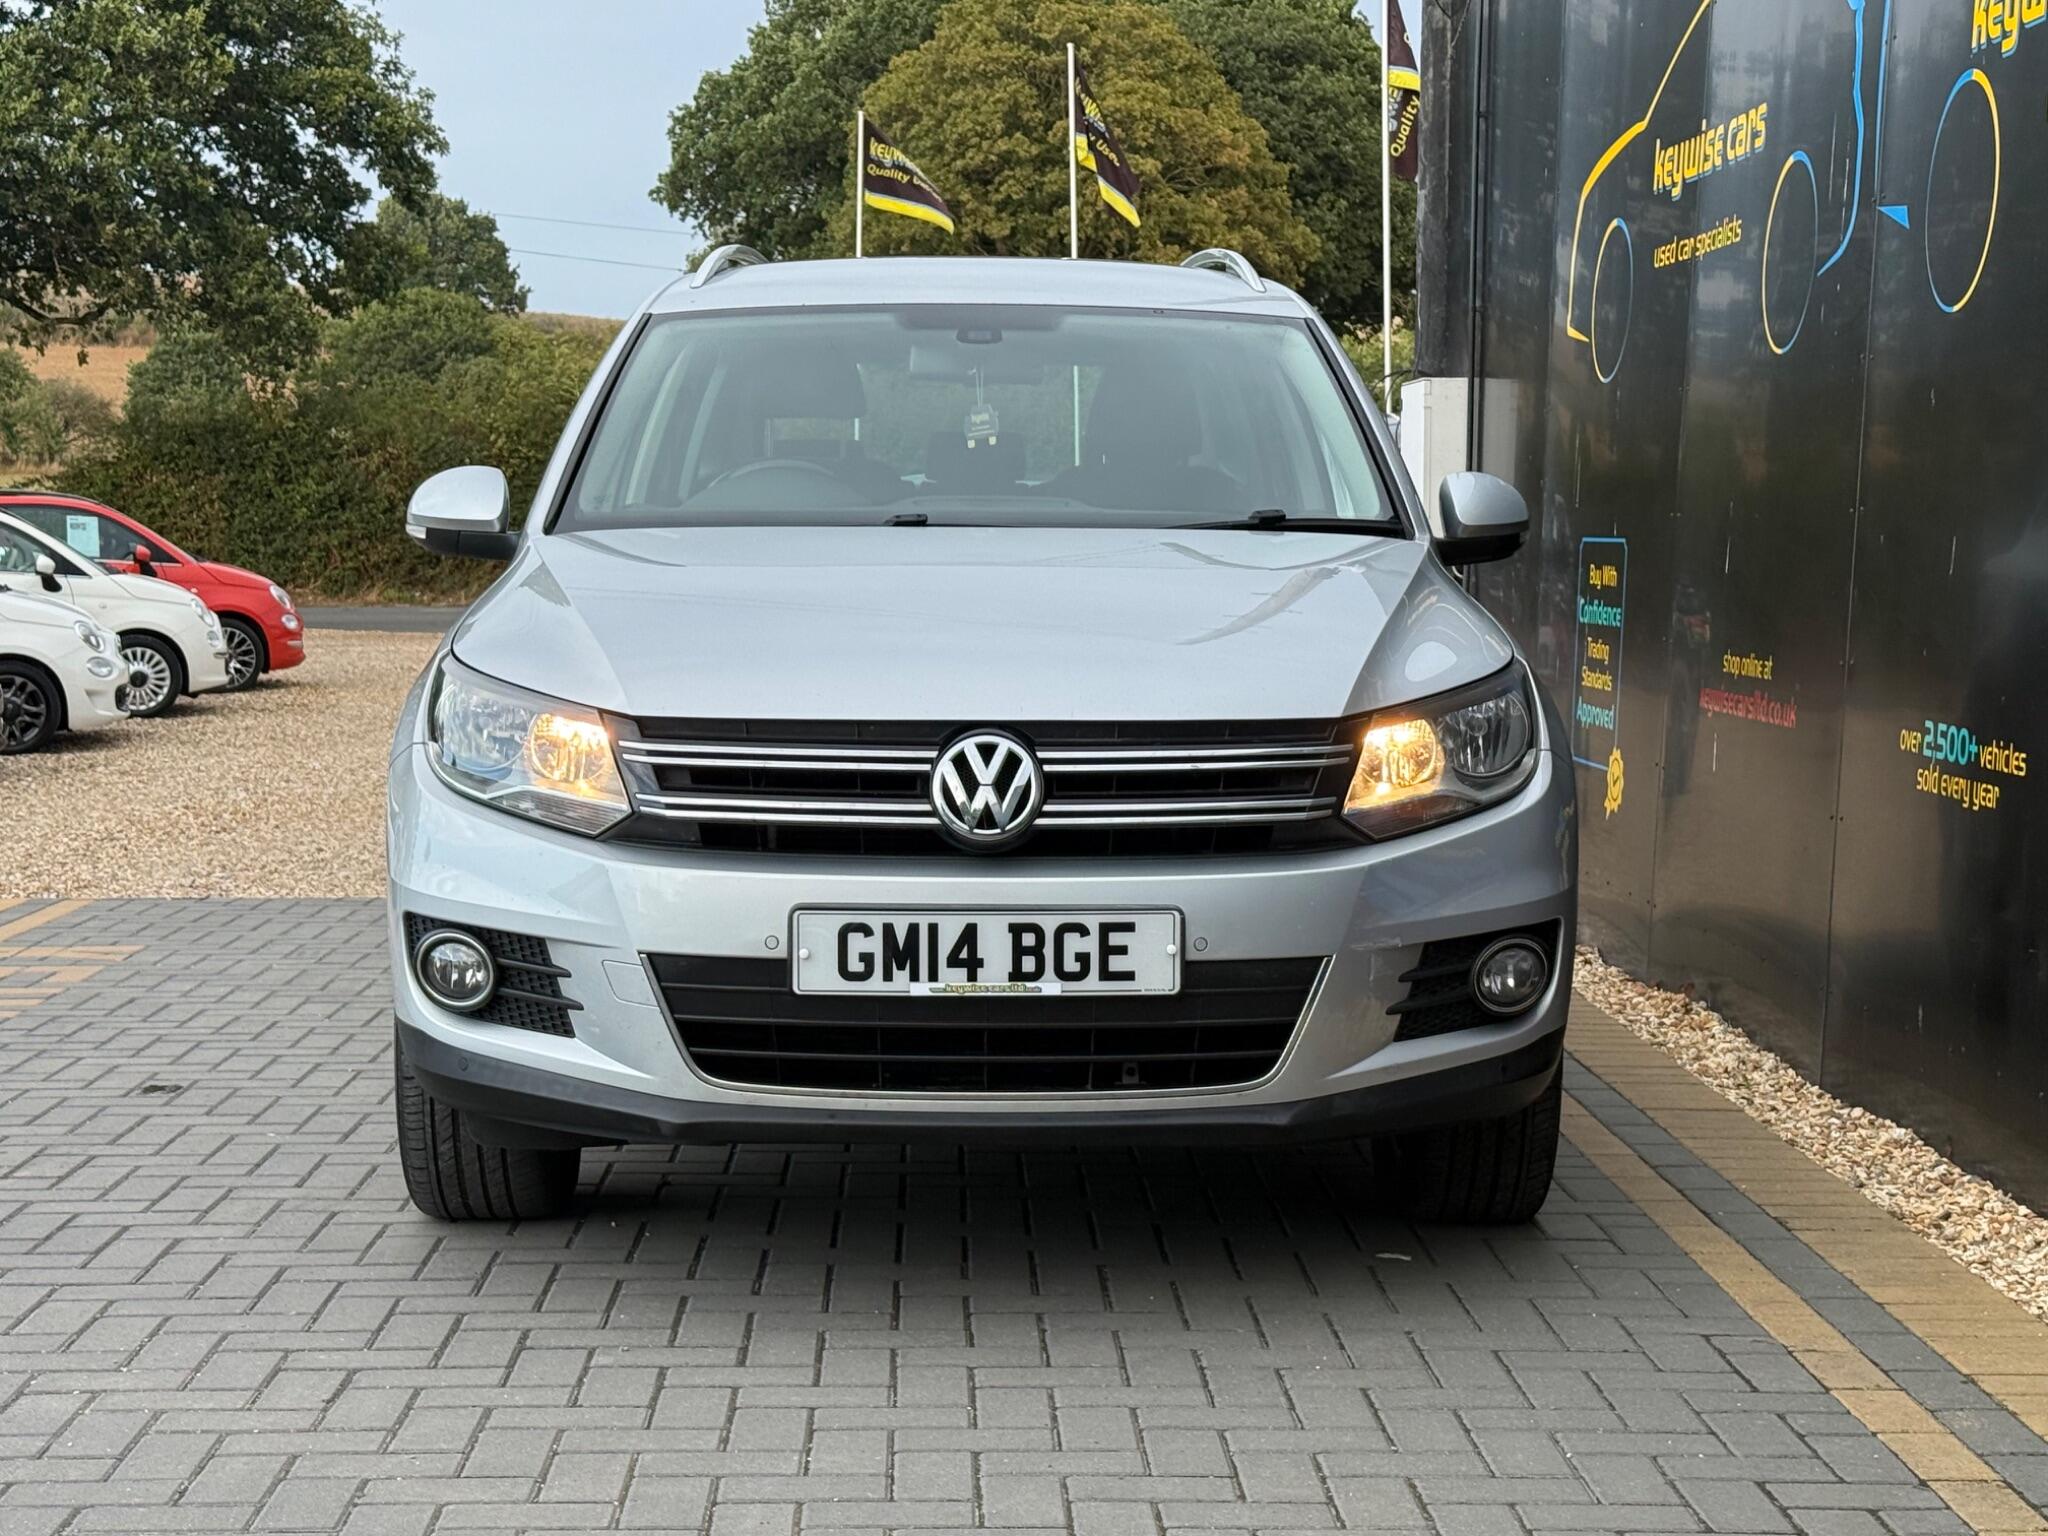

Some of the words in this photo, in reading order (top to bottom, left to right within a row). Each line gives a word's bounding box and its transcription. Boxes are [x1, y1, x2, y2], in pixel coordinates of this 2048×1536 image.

[1390, 95, 1421, 158] Quality
[1096, 139, 1120, 167] Use
[1653, 118, 1724, 201] keywise
[1727, 102, 1768, 165] cars
[866, 163, 910, 184] Quality
[1654, 235, 1676, 268] used
[1678, 237, 1695, 261] car
[1695, 214, 1742, 261] specialists
[1589, 564, 1601, 590] Buy
[1602, 565, 1618, 587] With
[1579, 598, 1622, 628] Confidence
[1587, 637, 1610, 665] Trading
[1723, 648, 1740, 679] shop
[1740, 653, 1763, 678] online
[1763, 655, 1773, 680] at
[1581, 666, 1613, 692] Standards
[1576, 696, 1615, 730] Approved
[1899, 729, 1921, 753] over
[1980, 739, 2027, 776] vehicles
[1916, 763, 1940, 794] sold
[1940, 774, 1970, 808] every
[1972, 781, 2000, 811] year
[837, 921, 985, 983] GM14
[1008, 921, 1137, 983] BGE
